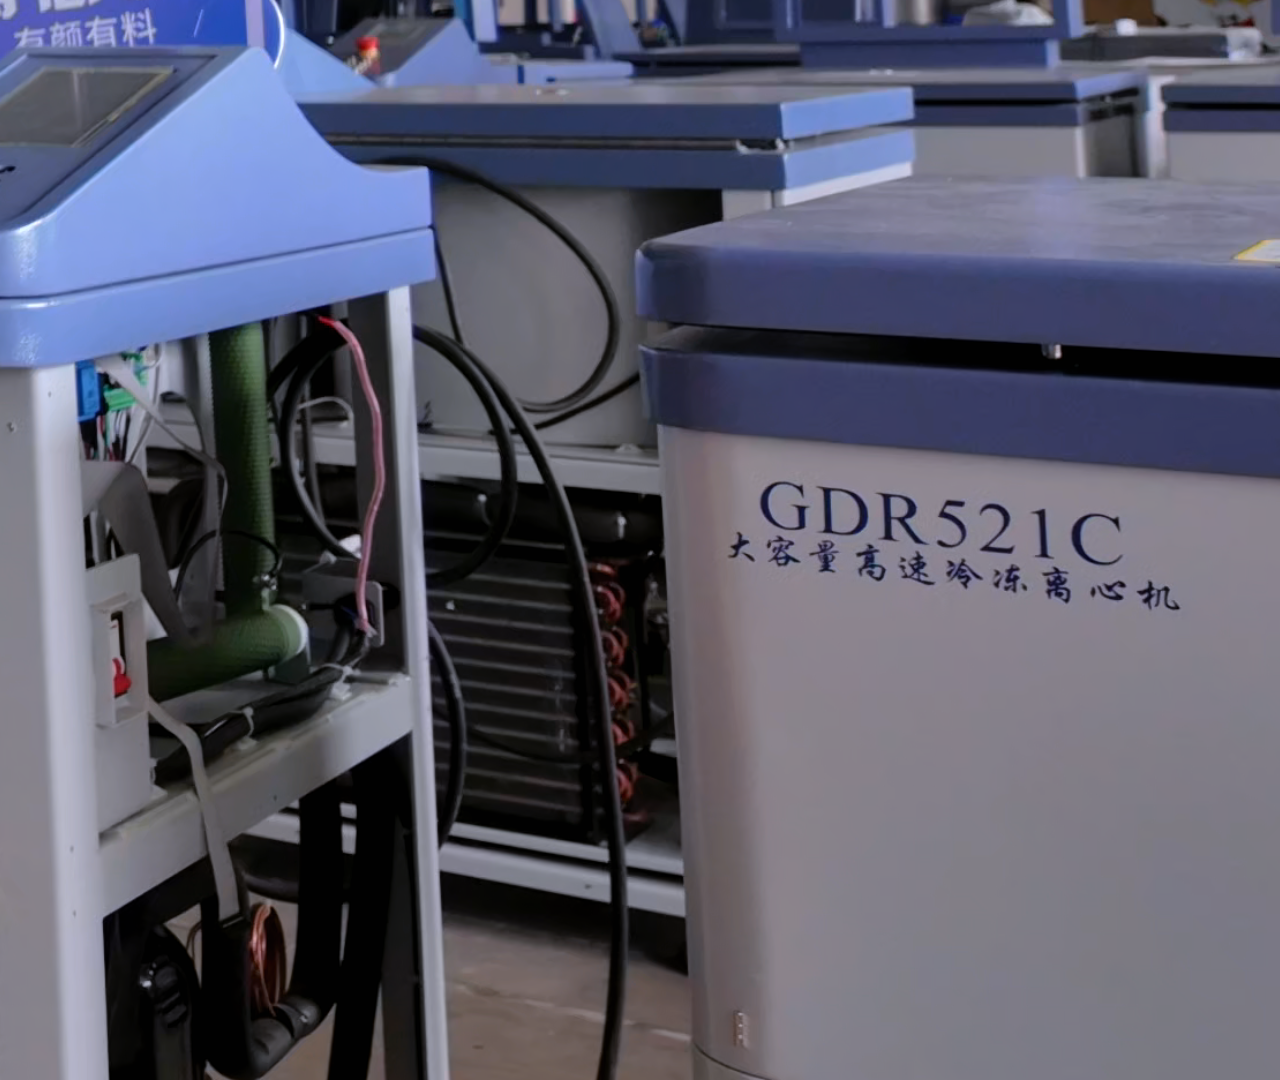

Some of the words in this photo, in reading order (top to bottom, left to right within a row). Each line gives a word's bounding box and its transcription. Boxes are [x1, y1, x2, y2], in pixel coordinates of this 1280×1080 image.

[14, 8, 158, 50] 有颜有料
[759, 480, 1124, 566] GDR521C
[727, 531, 1181, 612] 大容量高速冷冻离心机
